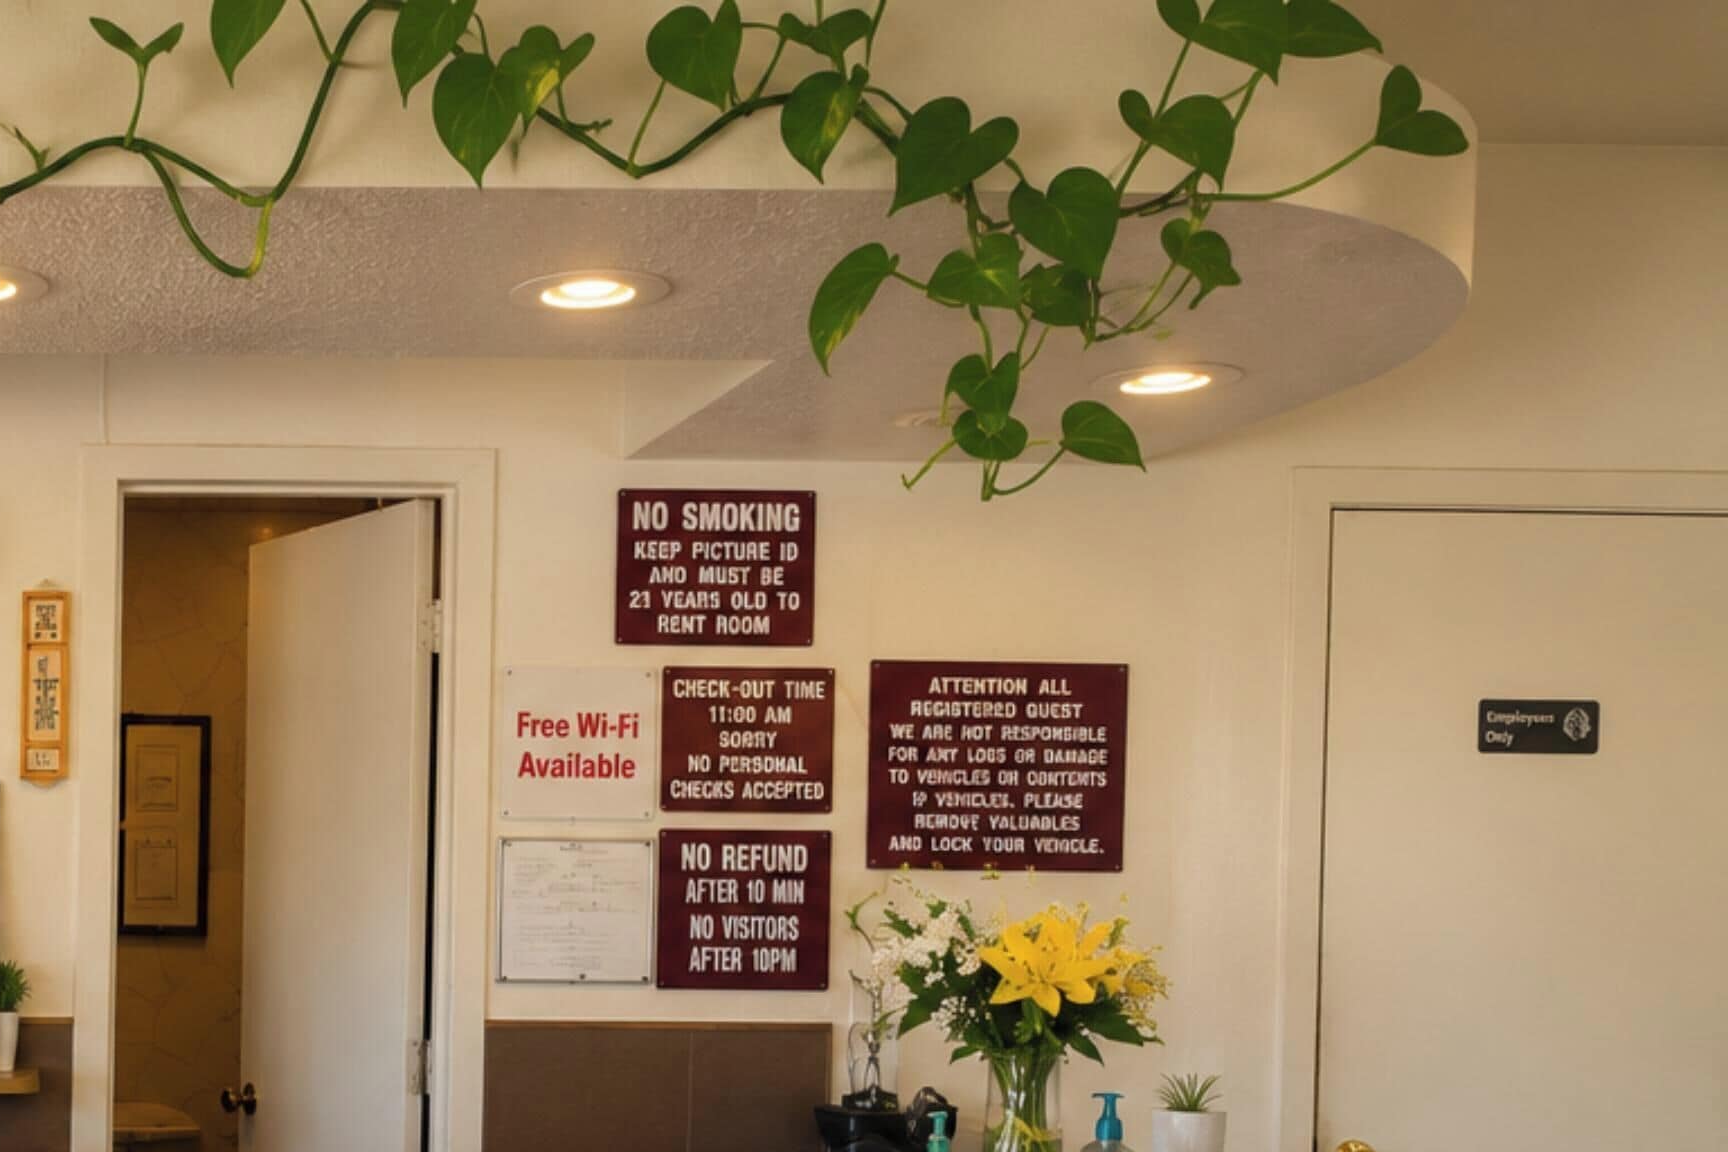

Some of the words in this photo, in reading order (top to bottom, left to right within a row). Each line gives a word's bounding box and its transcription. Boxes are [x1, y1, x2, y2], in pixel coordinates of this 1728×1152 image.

[633, 501, 669, 531] NO
[682, 502, 801, 532] SMOKING
[633, 541, 682, 561] KEEP
[691, 541, 771, 561] PICTURE
[779, 543, 799, 561] ID
[649, 566, 687, 584] AND
[699, 566, 751, 585] MUST
[760, 567, 785, 586] BE
[661, 590, 721, 609] YEARS
[731, 591, 767, 610] OLD
[776, 592, 800, 610] TO
[657, 614, 707, 634] RENT
[716, 616, 771, 635] ROOM
[673, 679, 775, 699] CHECK-OUT
[784, 681, 826, 699] TIME
[929, 676, 1027, 695] ATTENTION
[1039, 679, 1072, 695] ALL
[517, 711, 570, 738] Free
[576, 712, 639, 739] Wi-Fi
[709, 706, 756, 723] 11:00
[764, 706, 792, 724] AM
[719, 731, 777, 748] SORRY
[889, 724, 915, 740] WE
[922, 725, 953, 741] ARE
[961, 725, 993, 741] NOT
[1485, 730, 1514, 747] Only
[518, 752, 636, 778] Available
[687, 755, 711, 773] NO
[719, 756, 808, 774] PERSONAL
[887, 747, 919, 763] FOR
[1015, 749, 1036, 764] OR
[889, 769, 909, 785] TO
[670, 780, 734, 800] CHECKS
[742, 781, 824, 800] ACCEPTED
[888, 836, 922, 851] AND
[931, 836, 973, 852] LOCK
[983, 837, 1025, 853] YOUR
[681, 843, 712, 871] NO
[722, 844, 808, 873] REFUND
[685, 878, 739, 904] AFTER
[747, 879, 766, 904] 10
[773, 879, 805, 904] MIN
[690, 914, 714, 940] NO
[722, 915, 800, 941] VISITORS
[689, 947, 742, 972] AFTER
[752, 948, 797, 973] 10PM
